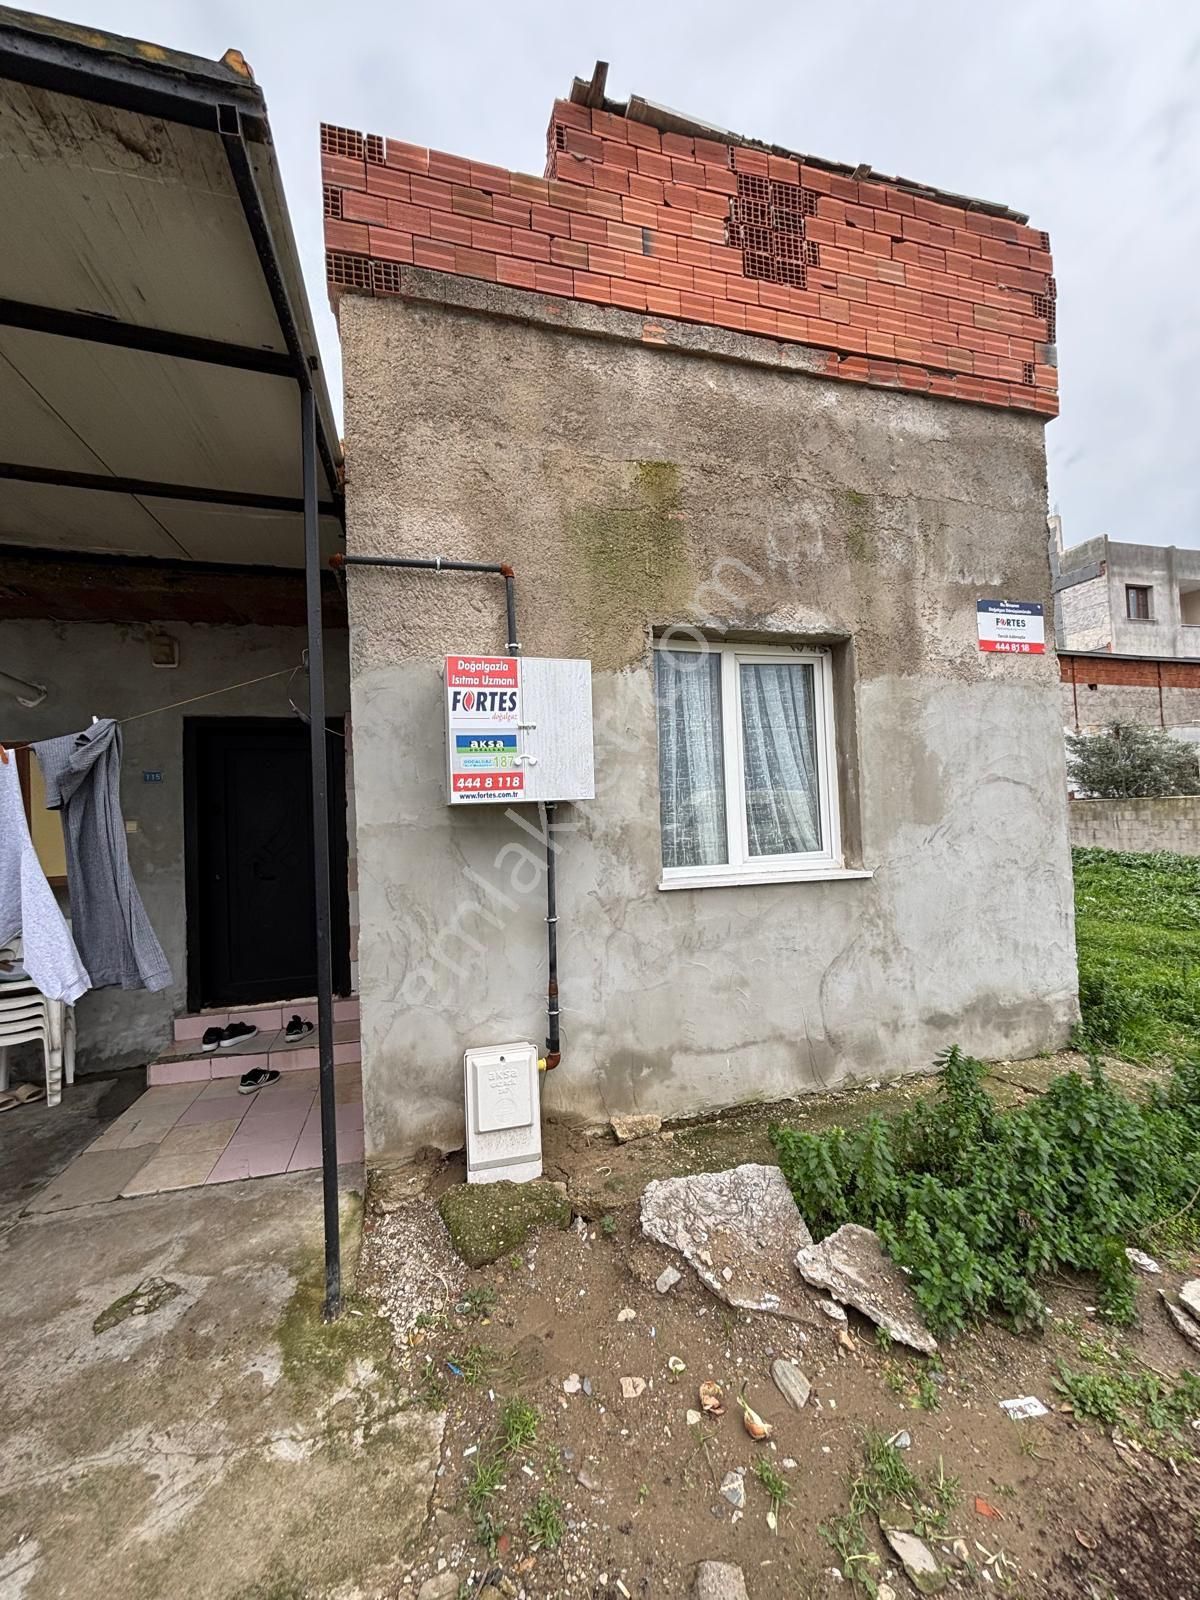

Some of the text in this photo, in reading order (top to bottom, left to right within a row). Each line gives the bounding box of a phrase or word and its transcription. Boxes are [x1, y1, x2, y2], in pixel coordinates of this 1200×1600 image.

[995, 617, 1026, 628] FORTES
[995, 642, 1010, 651] 444
[457, 660, 509, 673] Doğalgazla
[451, 674, 515, 686] Isıtma Uzmanı
[451, 690, 517, 712] FORTES
[494, 755, 514, 768] 187
[456, 776, 520, 789] 444 8 118
[459, 791, 519, 800] www.fortes.com.tr
